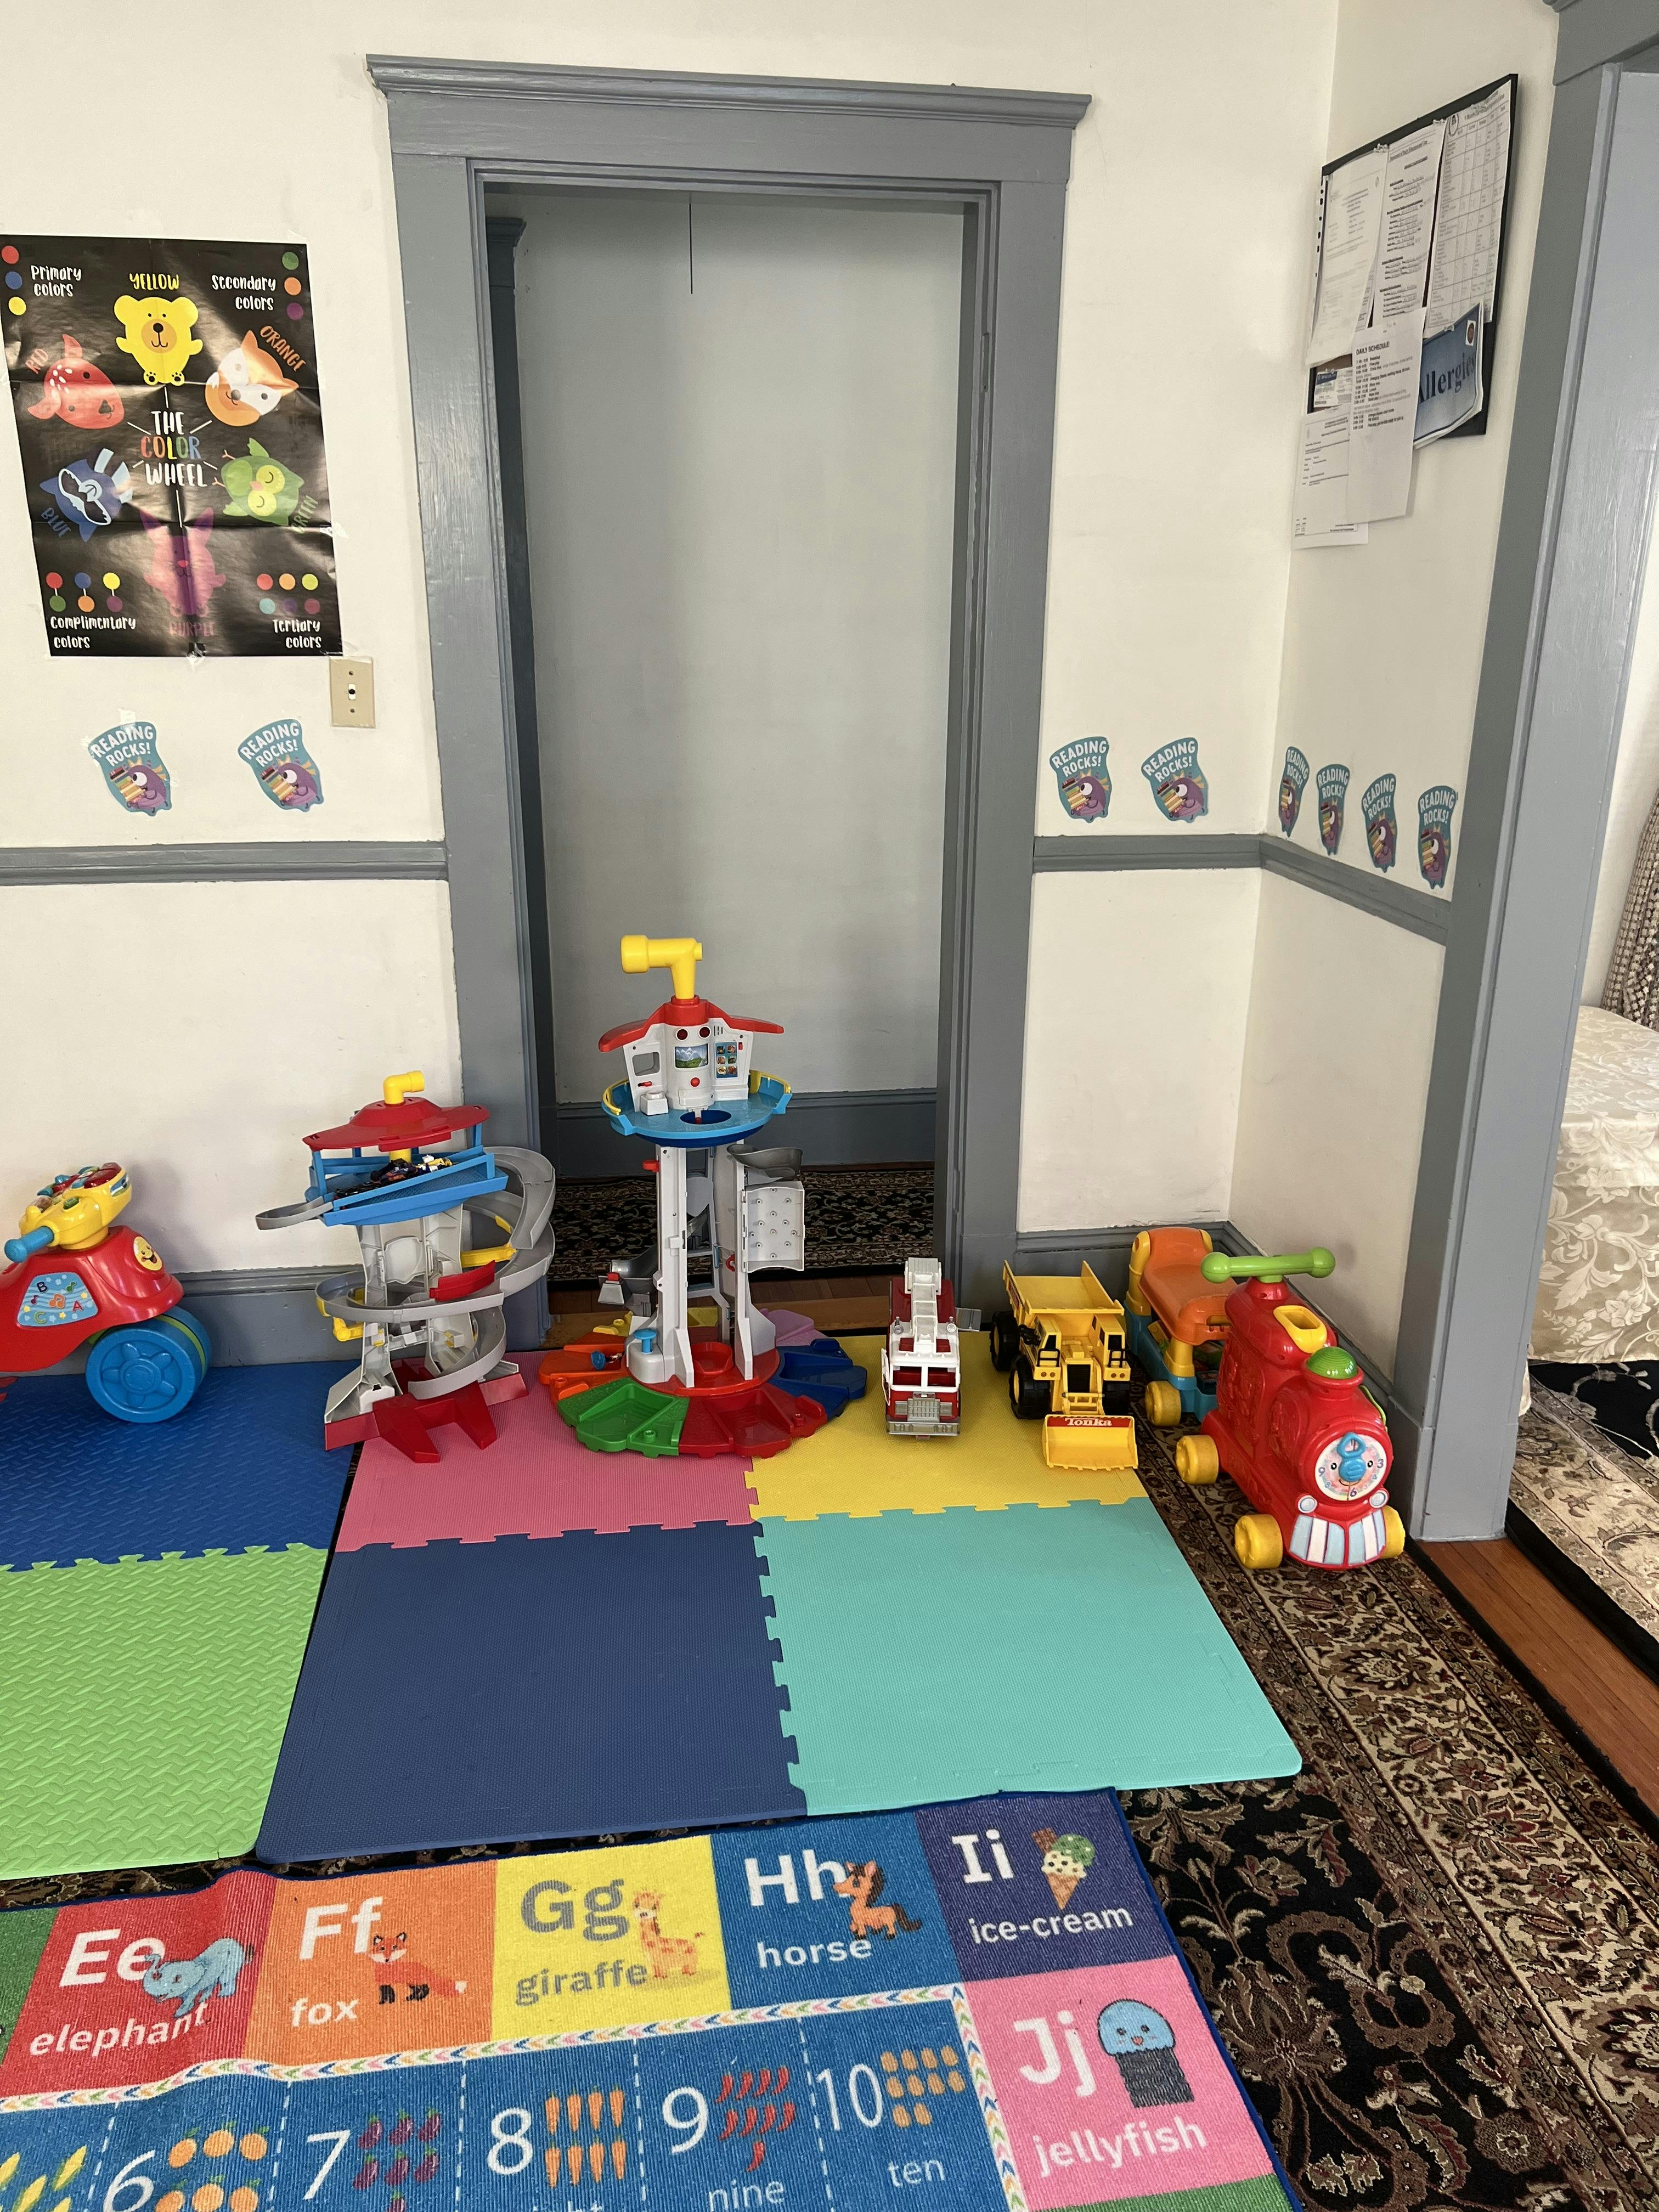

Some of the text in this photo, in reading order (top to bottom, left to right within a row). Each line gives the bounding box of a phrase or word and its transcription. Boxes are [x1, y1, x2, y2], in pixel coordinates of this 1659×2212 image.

[31, 265, 82, 281] Primary
[129, 273, 179, 290] YELLOW
[211, 274, 276, 291] Secondary
[34, 281, 74, 297] colors
[235, 295, 274, 311] colors
[25, 348, 48, 374] RED
[260, 325, 306, 371] ORANGE
[1356, 341, 1390, 356] DAILY SCHEDULE
[151, 411, 184, 435] THE
[140, 436, 201, 460] COLOR
[145, 462, 208, 487] WHEEL
[41, 507, 71, 538] BLUE
[291, 494, 318, 534] GREEN
[50, 616, 136, 630] Complimentary
[169, 620, 215, 637] PURPLE
[272, 619, 320, 633] Tertiary
[54, 635, 90, 648] colors
[285, 635, 322, 648] colors
[91, 726, 154, 758] READING
[240, 722, 300, 760] READING
[255, 739, 299, 767] ROCKS!
[105, 742, 151, 767] ROCKS!
[1052, 740, 1107, 769] READING
[1062, 755, 1102, 777] ROCKS!
[1143, 741, 1196, 776] READING
[1286, 749, 1309, 780] READING
[1154, 756, 1192, 782] ROCKS!
[1286, 764, 1303, 787] ROCKS!
[1317, 768, 1349, 787] READING
[1322, 783, 1344, 799] ROCKS!
[1362, 777, 1396, 811] READING
[1419, 789, 1455, 812] READING
[1368, 795, 1391, 820] ROCKS!
[1424, 808, 1448, 825] ROCKS!
[36, 1282, 48, 1293] B
[34, 1311, 47, 1324] C
[72, 1300, 84, 1312] A
[1064, 1418, 1112, 1426] Tonka
[1318, 1466, 1325, 1477] 9
[1377, 1459, 1384, 1469] 3
[1350, 1487, 1357, 1497] 6
[951, 1829, 1014, 1883] Ii
[744, 1849, 851, 1907] Hh
[521, 1878, 630, 1942] Gg
[300, 1896, 383, 1960] Ff
[968, 1904, 1133, 1945] ice-cream
[59, 1928, 167, 1987] Ee
[757, 1938, 873, 1969] horse
[515, 1960, 648, 2007] giraffe
[291, 1995, 359, 2027] fox
[30, 2001, 210, 2057] elephant
[1013, 2010, 1096, 2099] Jj
[815, 2063, 884, 2131] 10
[662, 2086, 708, 2154] 9
[488, 2107, 533, 2175] 8
[1032, 2120, 1207, 2178] jellyfish
[303, 2130, 351, 2200] 7
[887, 2156, 945, 2188] ten
[103, 2149, 155, 2212] 6
[708, 2179, 785, 2212] nine
